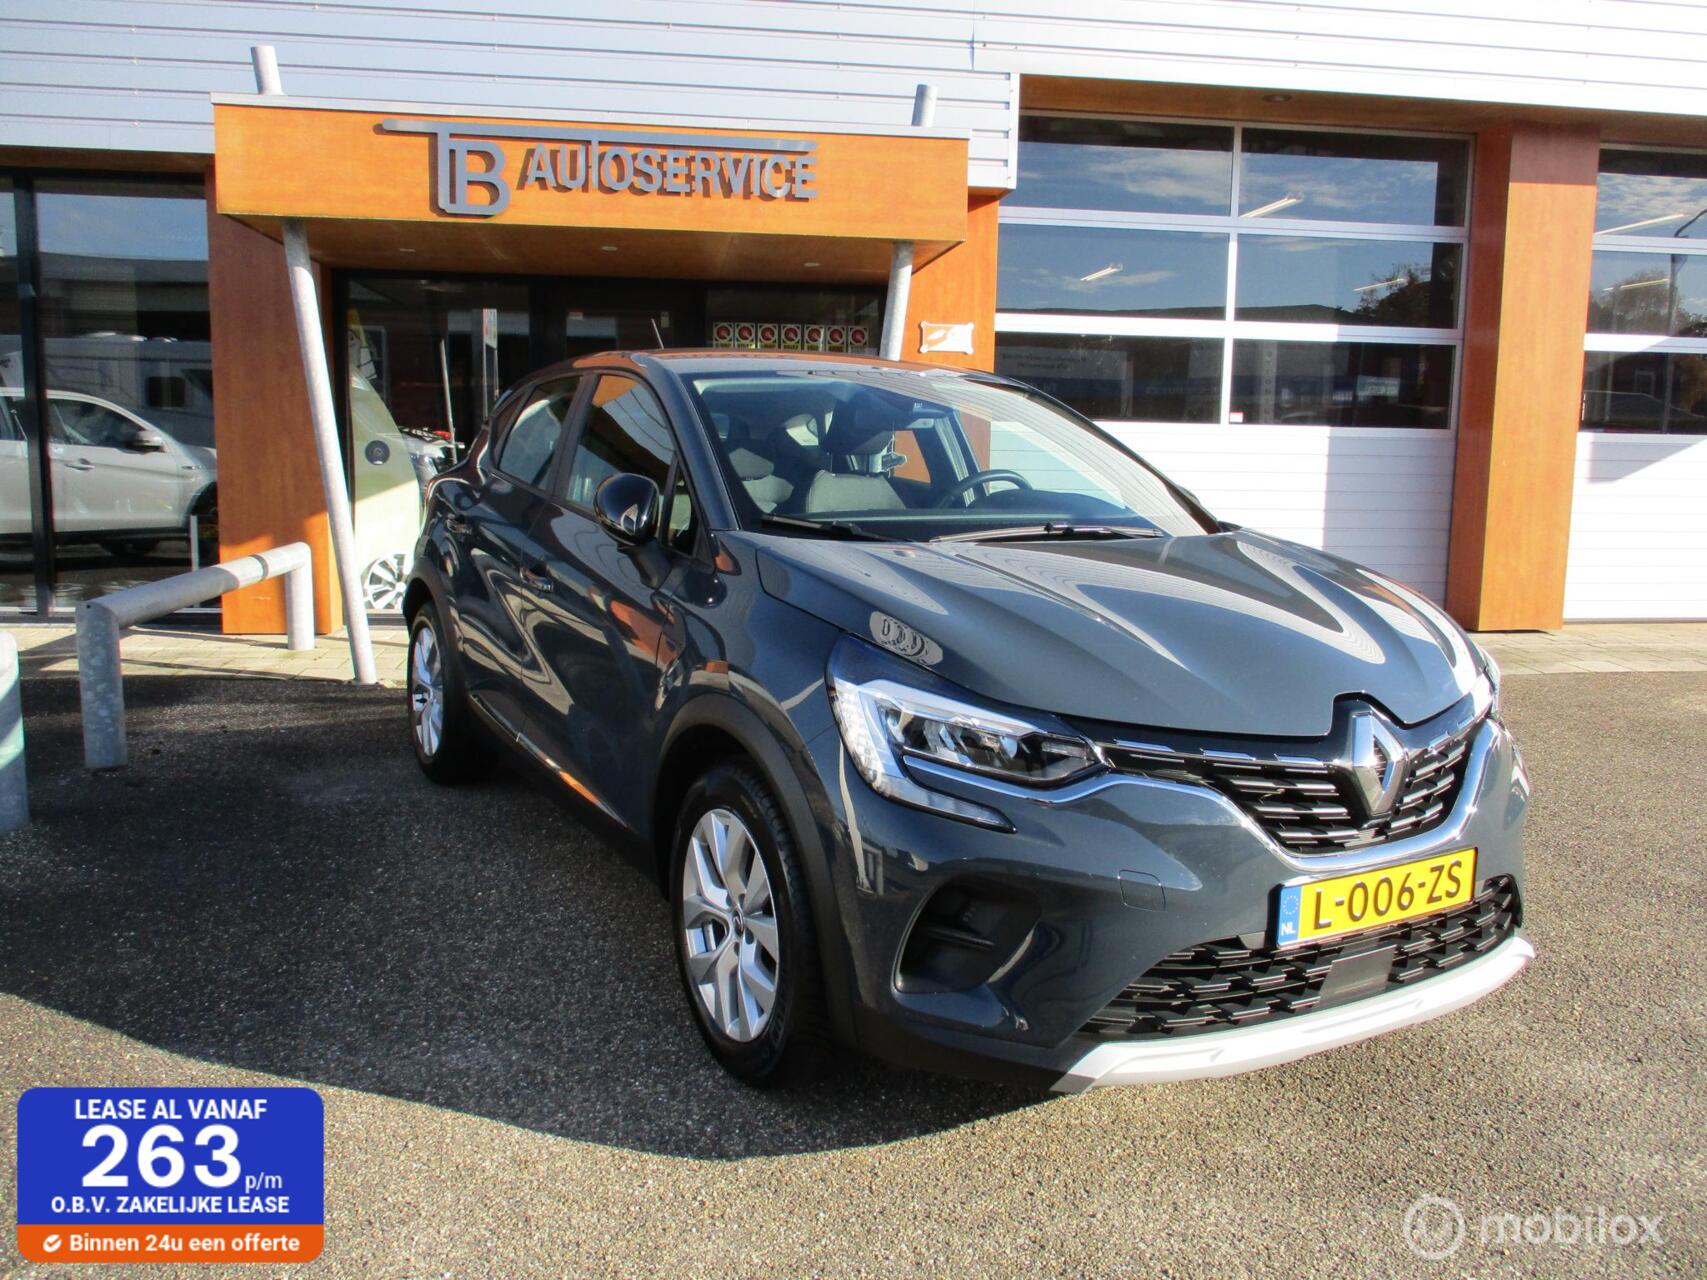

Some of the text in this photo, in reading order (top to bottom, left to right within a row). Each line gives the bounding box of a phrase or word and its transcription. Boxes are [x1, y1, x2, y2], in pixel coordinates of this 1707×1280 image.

[526, 138, 818, 200] AUTOSERVICE
[1313, 860, 1463, 930] L-006-ZS
[1281, 922, 1296, 936] NL
